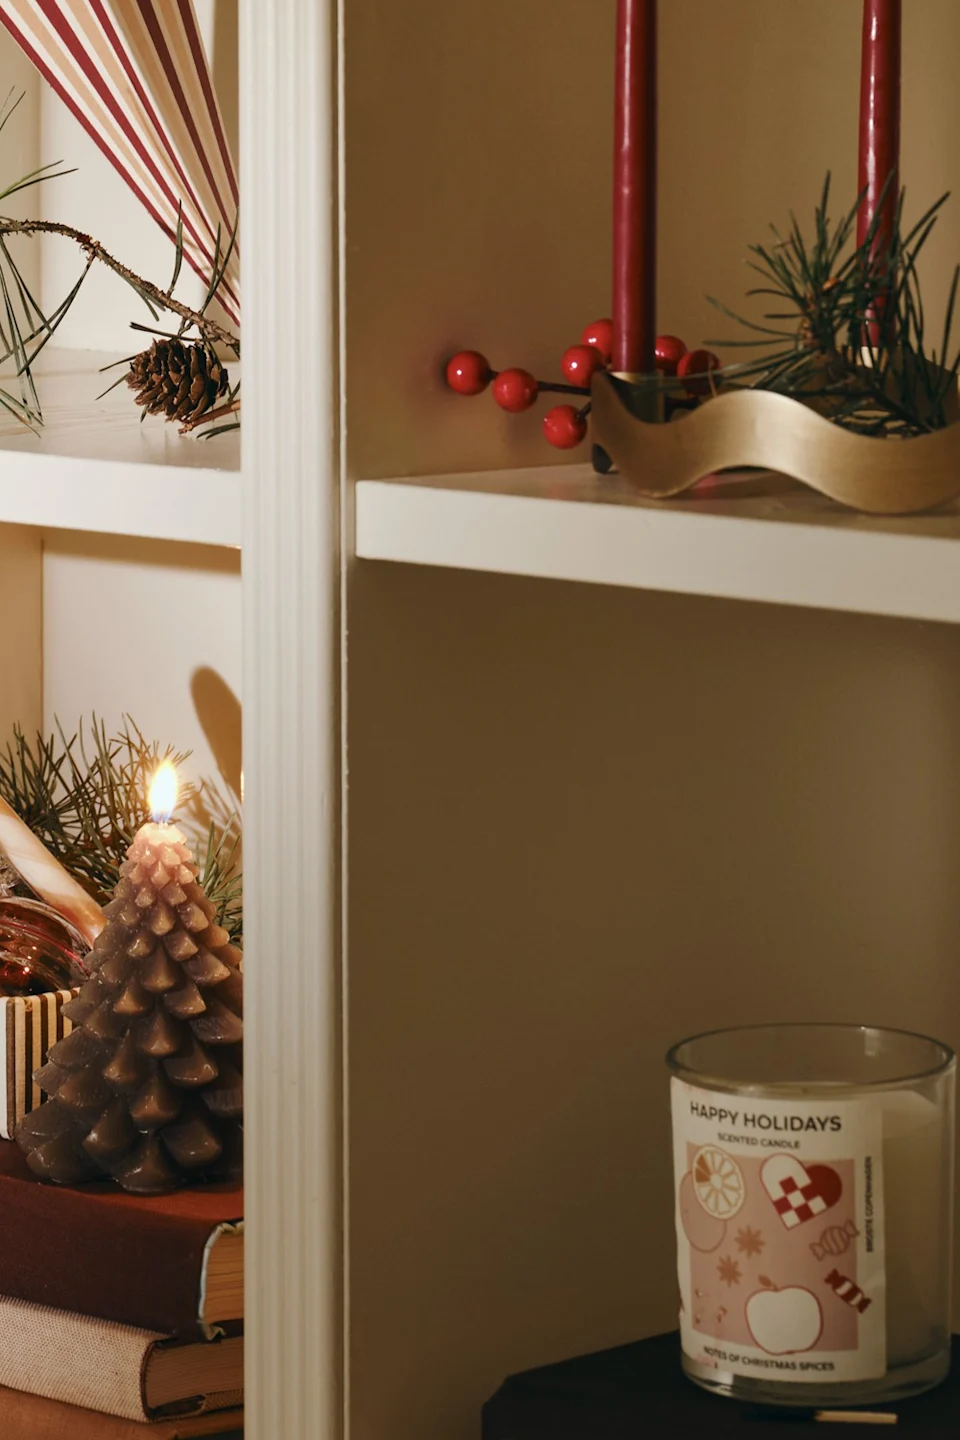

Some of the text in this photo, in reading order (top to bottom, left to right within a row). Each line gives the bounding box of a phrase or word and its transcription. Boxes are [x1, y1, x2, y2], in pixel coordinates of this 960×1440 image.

[690, 1101, 842, 1132] HAPPY HOLIDAYS
[717, 1132, 800, 1150] SCENTED CANDLE
[704, 1346, 835, 1371] NOTES OF CHRISTMAS SPICES
